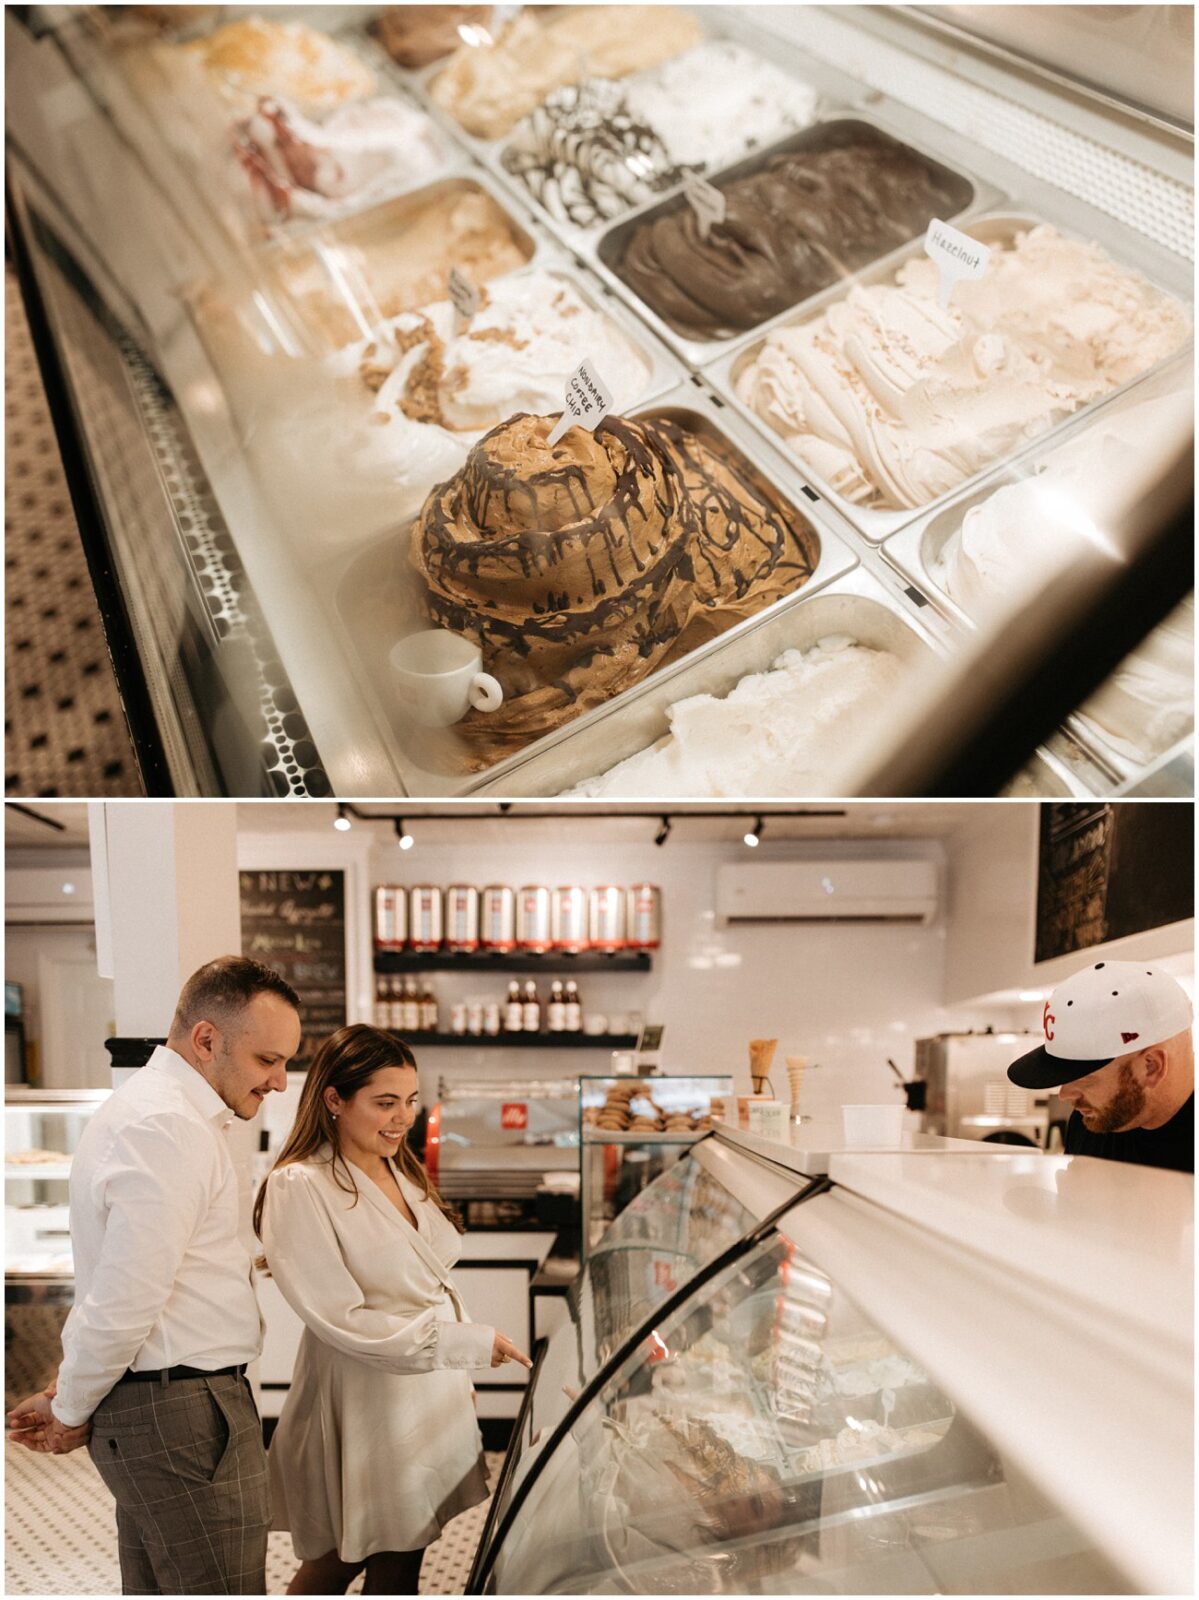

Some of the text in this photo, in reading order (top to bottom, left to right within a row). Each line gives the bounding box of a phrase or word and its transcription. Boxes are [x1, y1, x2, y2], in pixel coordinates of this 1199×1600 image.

[931, 231, 980, 269] Hazelnut
[565, 392, 581, 417] CHIP
[570, 377, 593, 413] COFFEE
[258, 872, 316, 892] NEW
